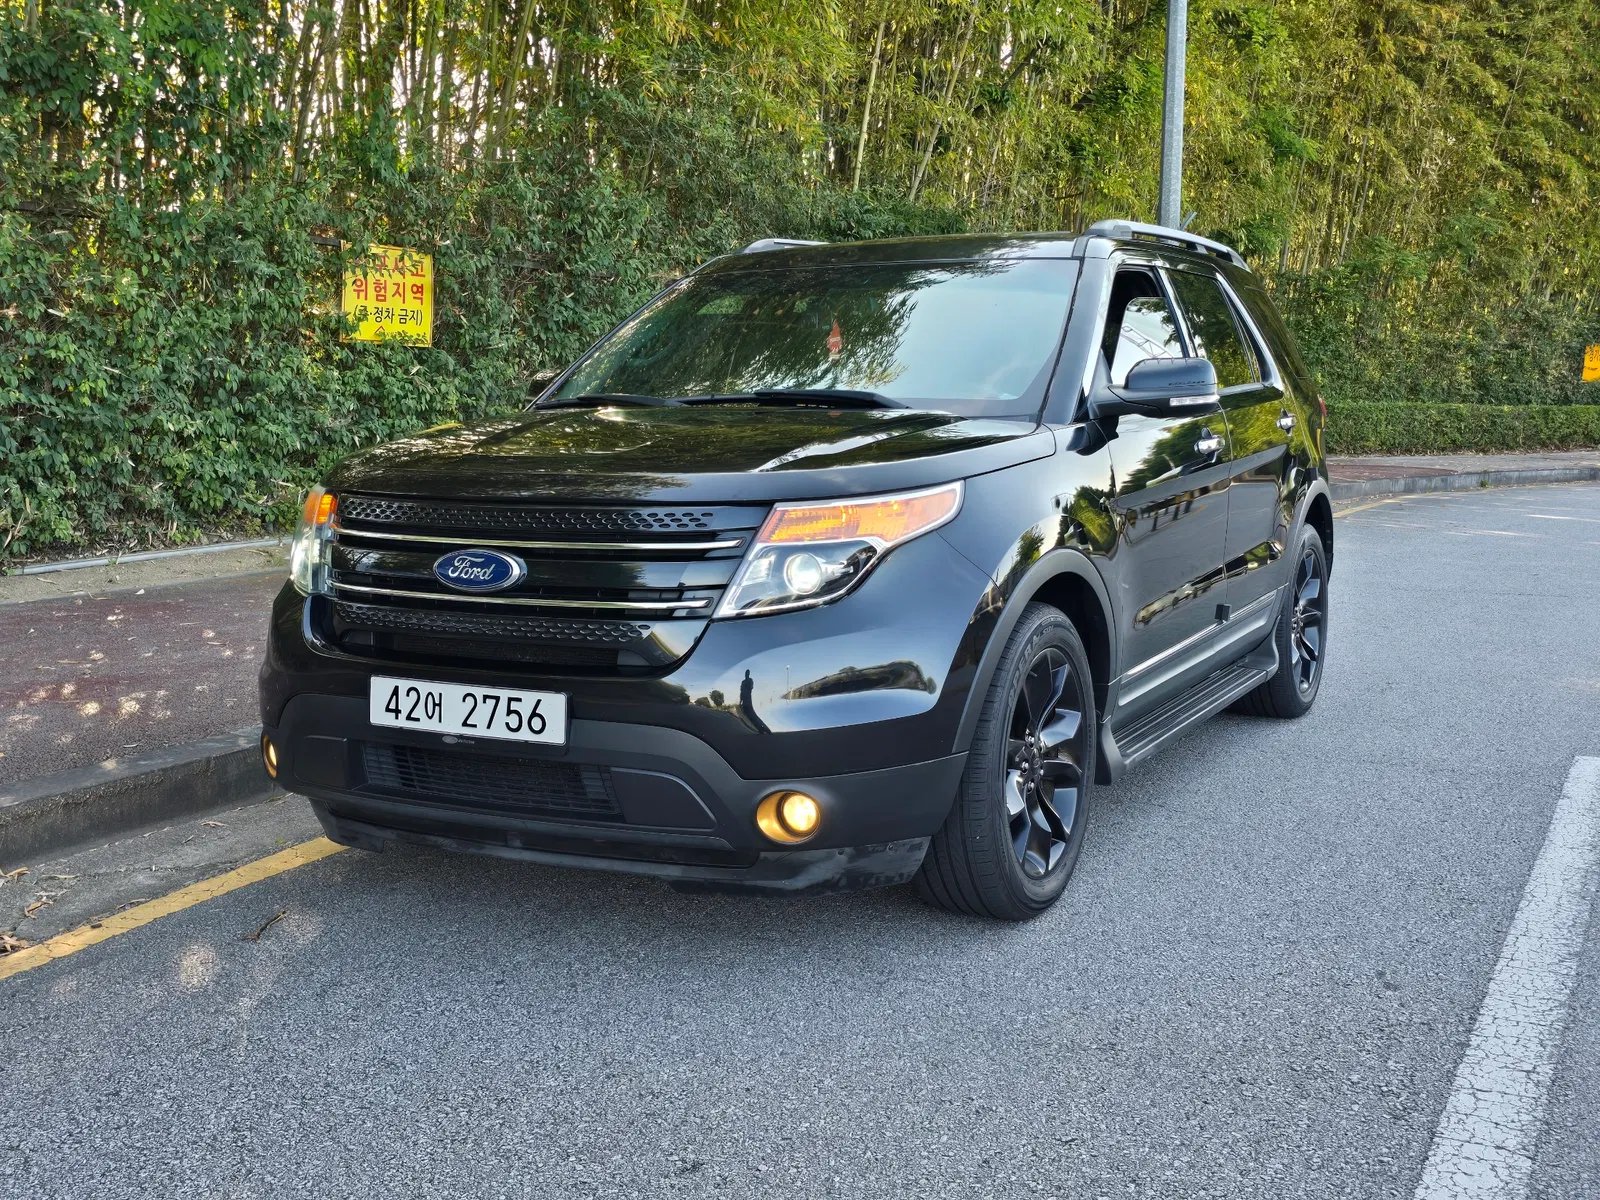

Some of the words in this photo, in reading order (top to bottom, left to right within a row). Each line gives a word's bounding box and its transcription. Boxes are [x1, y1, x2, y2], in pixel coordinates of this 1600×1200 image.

[354, 253, 426, 279] 구사고
[353, 278, 424, 306] 위험지역
[448, 555, 496, 580] Ford
[384, 685, 443, 723] 42어
[461, 692, 547, 735] 2756
